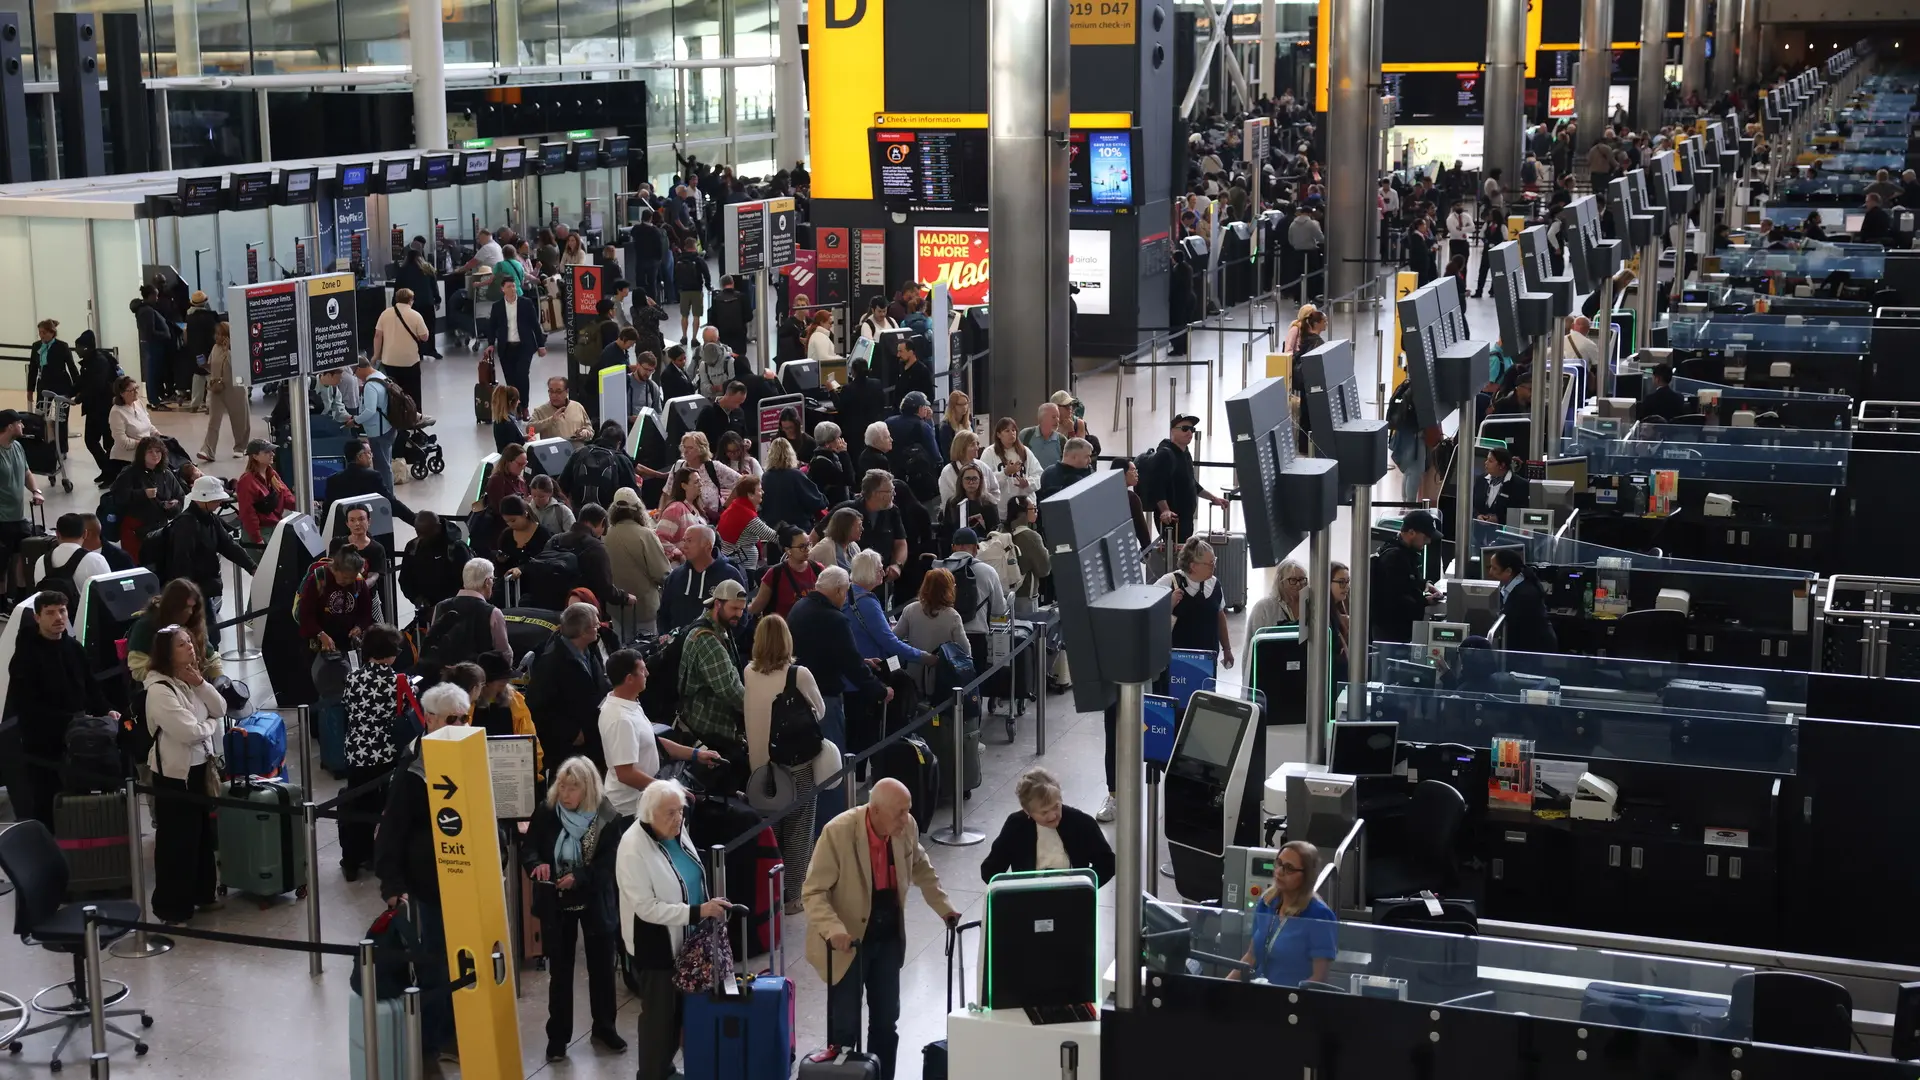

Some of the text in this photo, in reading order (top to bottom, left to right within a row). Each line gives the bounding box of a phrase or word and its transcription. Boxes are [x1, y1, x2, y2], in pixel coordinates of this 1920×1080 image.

[825, 0, 867, 28] D
[1101, 3, 1128, 15] D47
[1099, 148, 1122, 157] 10%
[339, 213, 357, 224] SkyFix
[828, 235, 837, 247] 2
[920, 233, 969, 245] MADRID
[920, 246, 969, 257] IS MORE
[322, 281, 336, 289] Zone
[584, 275, 590, 288] 1
[261, 297, 279, 305] baggage
[316, 330, 352, 342] Flight Information
[332, 339, 347, 347] screens
[323, 350, 333, 359] your
[333, 346, 349, 355] airline's
[1171, 676, 1186, 684] Exit
[1152, 725, 1166, 735] Exit
[441, 842, 465, 855] Exit
[438, 857, 471, 866] Departures
